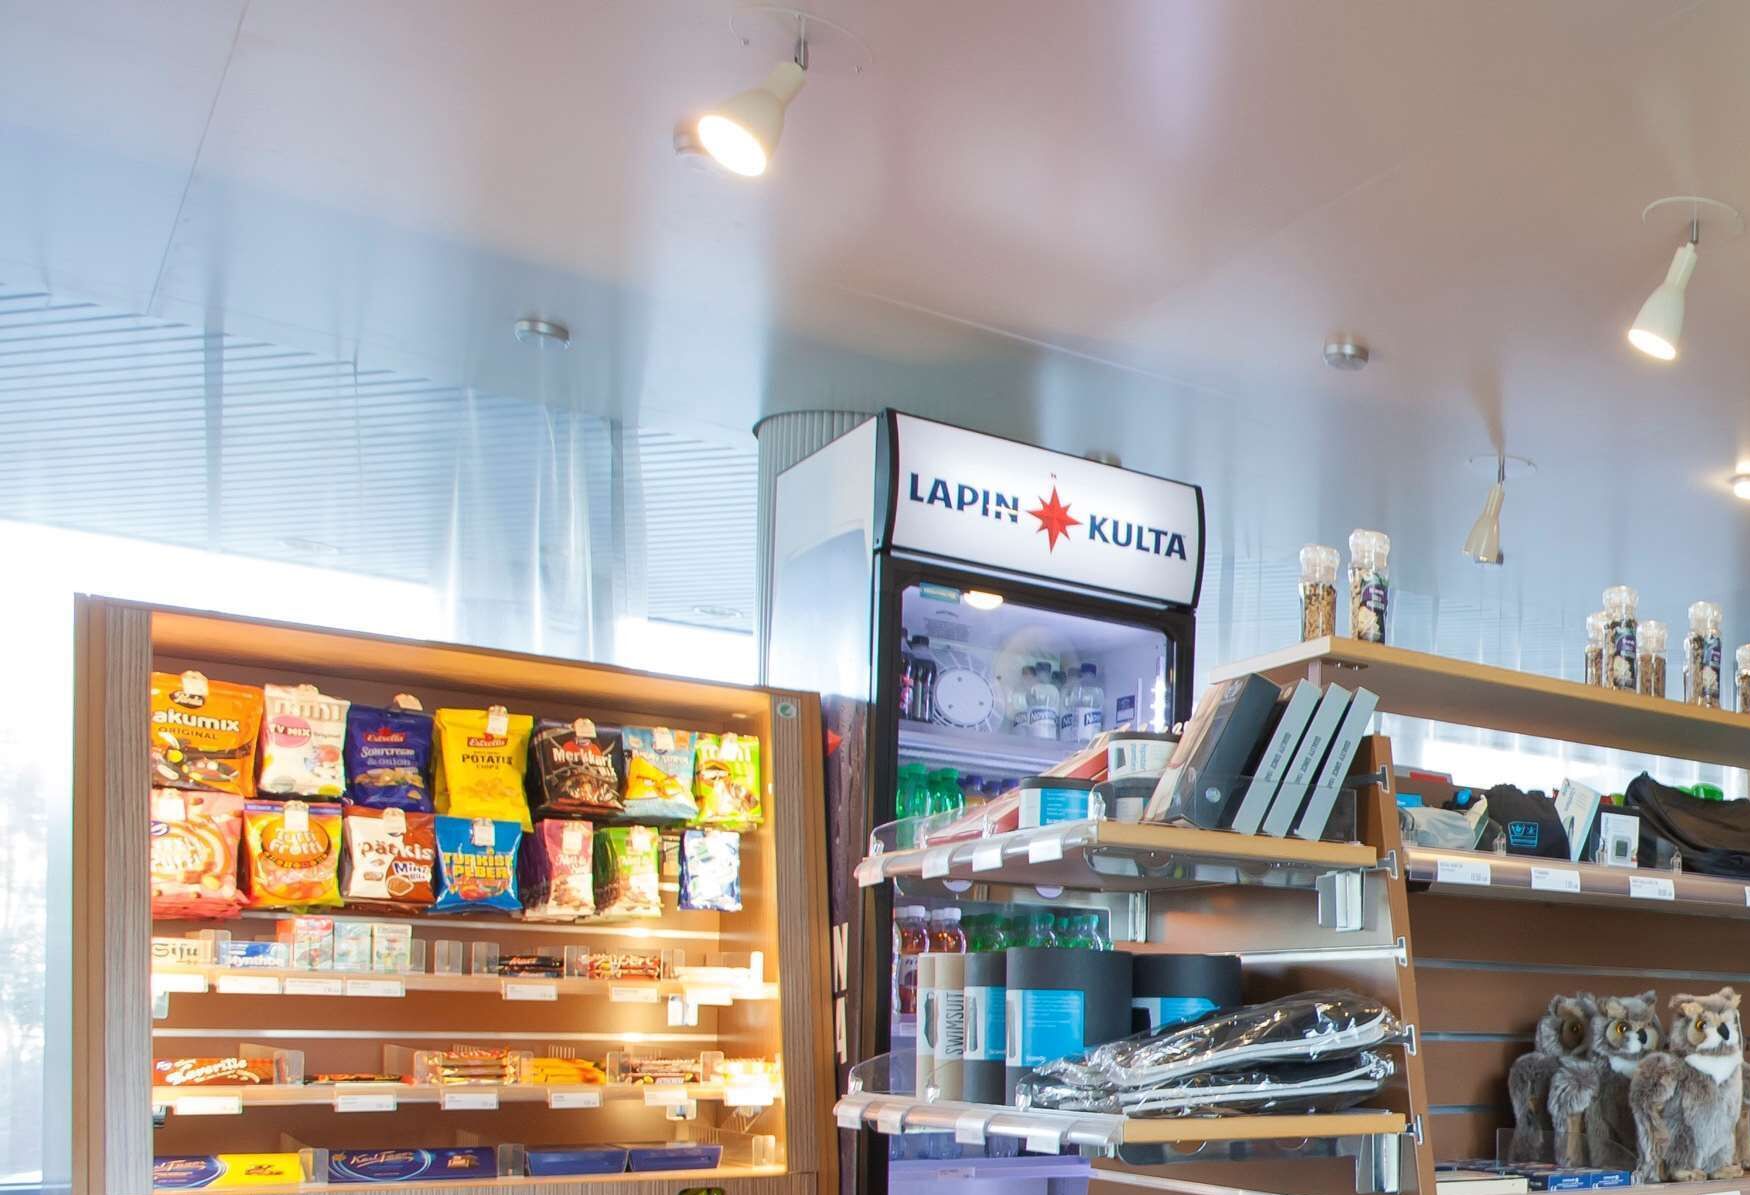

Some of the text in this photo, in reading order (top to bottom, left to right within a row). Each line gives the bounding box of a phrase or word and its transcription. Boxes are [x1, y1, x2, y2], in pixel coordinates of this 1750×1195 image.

[909, 472, 1187, 561] LAPIN KULTA
[152, 708, 240, 733] akumix
[945, 992, 964, 1056] SWIMSUIT
